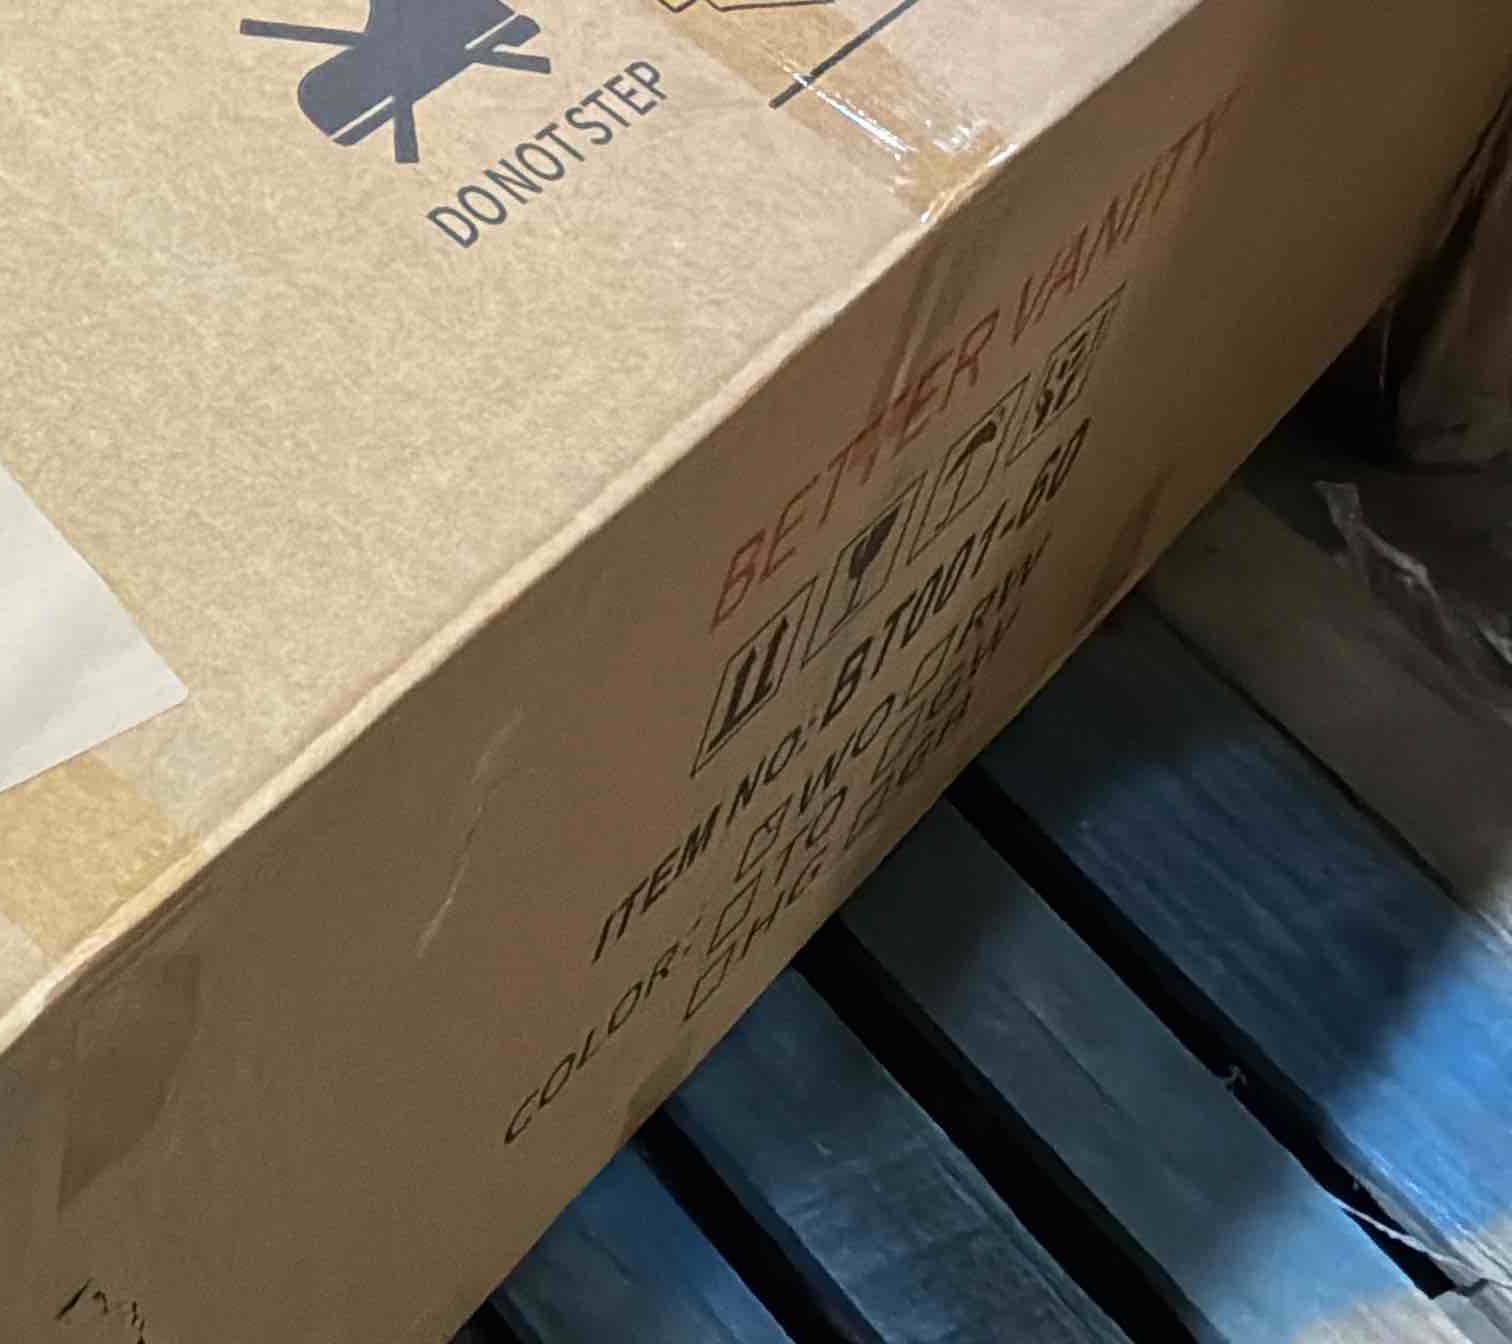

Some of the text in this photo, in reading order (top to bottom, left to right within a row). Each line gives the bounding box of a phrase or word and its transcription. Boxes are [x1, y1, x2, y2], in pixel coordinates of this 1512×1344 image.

[565, 61, 667, 145] STEP
[710, 309, 1000, 631] BETTER
[593, 802, 722, 964] ITEM
[775, 786, 847, 885] TO
[504, 916, 701, 1144] COLOR:
[800, 693, 896, 815] WO
